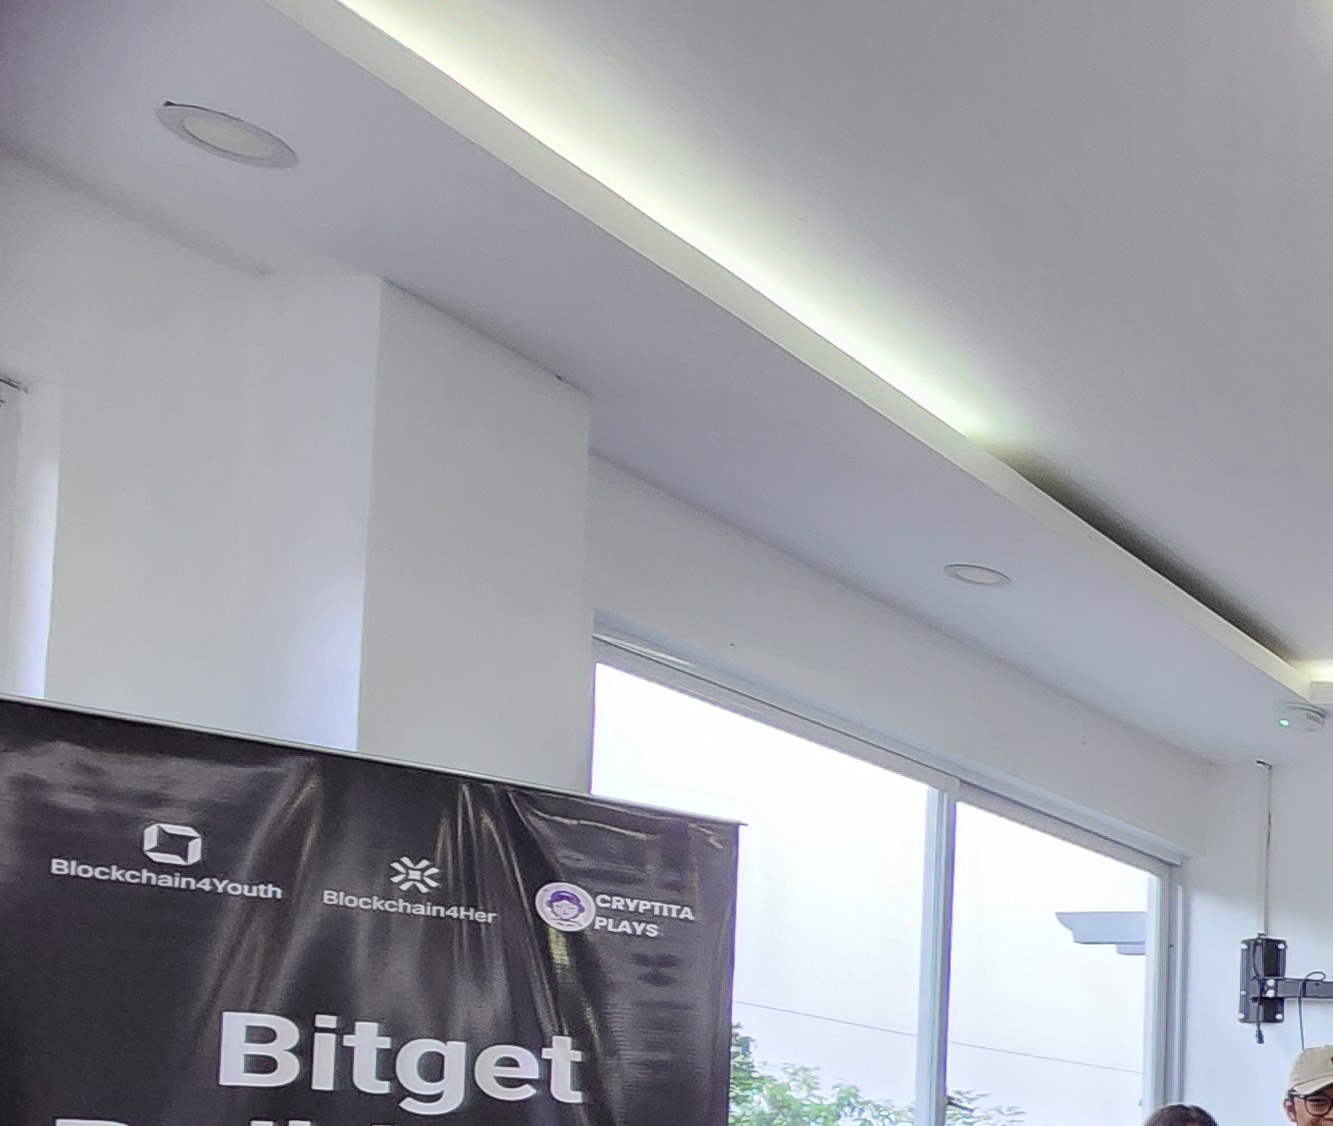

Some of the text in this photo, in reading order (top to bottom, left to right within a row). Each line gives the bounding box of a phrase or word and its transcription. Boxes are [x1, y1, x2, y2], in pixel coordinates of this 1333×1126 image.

[50, 857, 283, 899] Blockchain4Youth
[322, 890, 498, 924] Blockchain4Her
[595, 894, 695, 921] CRYPTITA
[593, 916, 659, 938] PLAYS
[218, 1010, 583, 1115] Bitget
